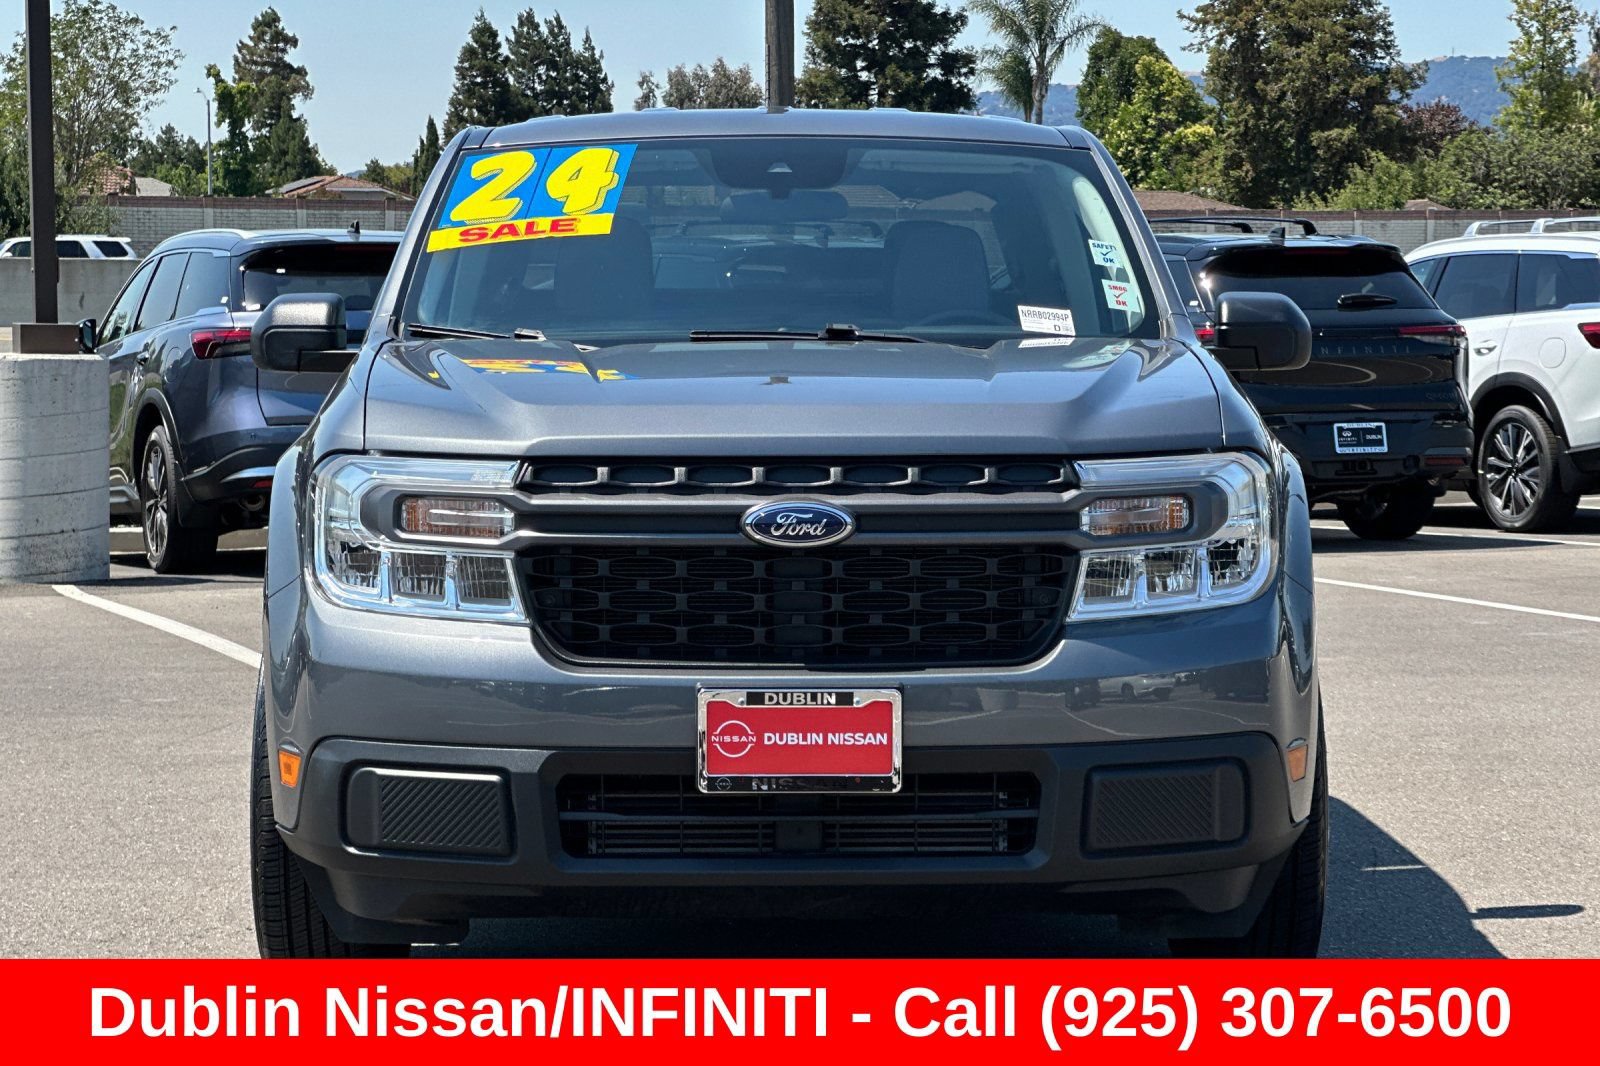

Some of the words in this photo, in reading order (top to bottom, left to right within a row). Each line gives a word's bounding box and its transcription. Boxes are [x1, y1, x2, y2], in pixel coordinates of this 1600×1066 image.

[450, 147, 620, 225] 24
[458, 217, 580, 243] SALE
[1107, 284, 1128, 292] SMOG
[1115, 299, 1128, 307] OK
[1320, 345, 1411, 355] NFINITI
[771, 512, 827, 536] Ford
[764, 692, 836, 705] DUBLIN
[711, 735, 757, 743] NISSAN
[764, 732, 823, 746] DUBLIN
[827, 732, 888, 746] NISSAN
